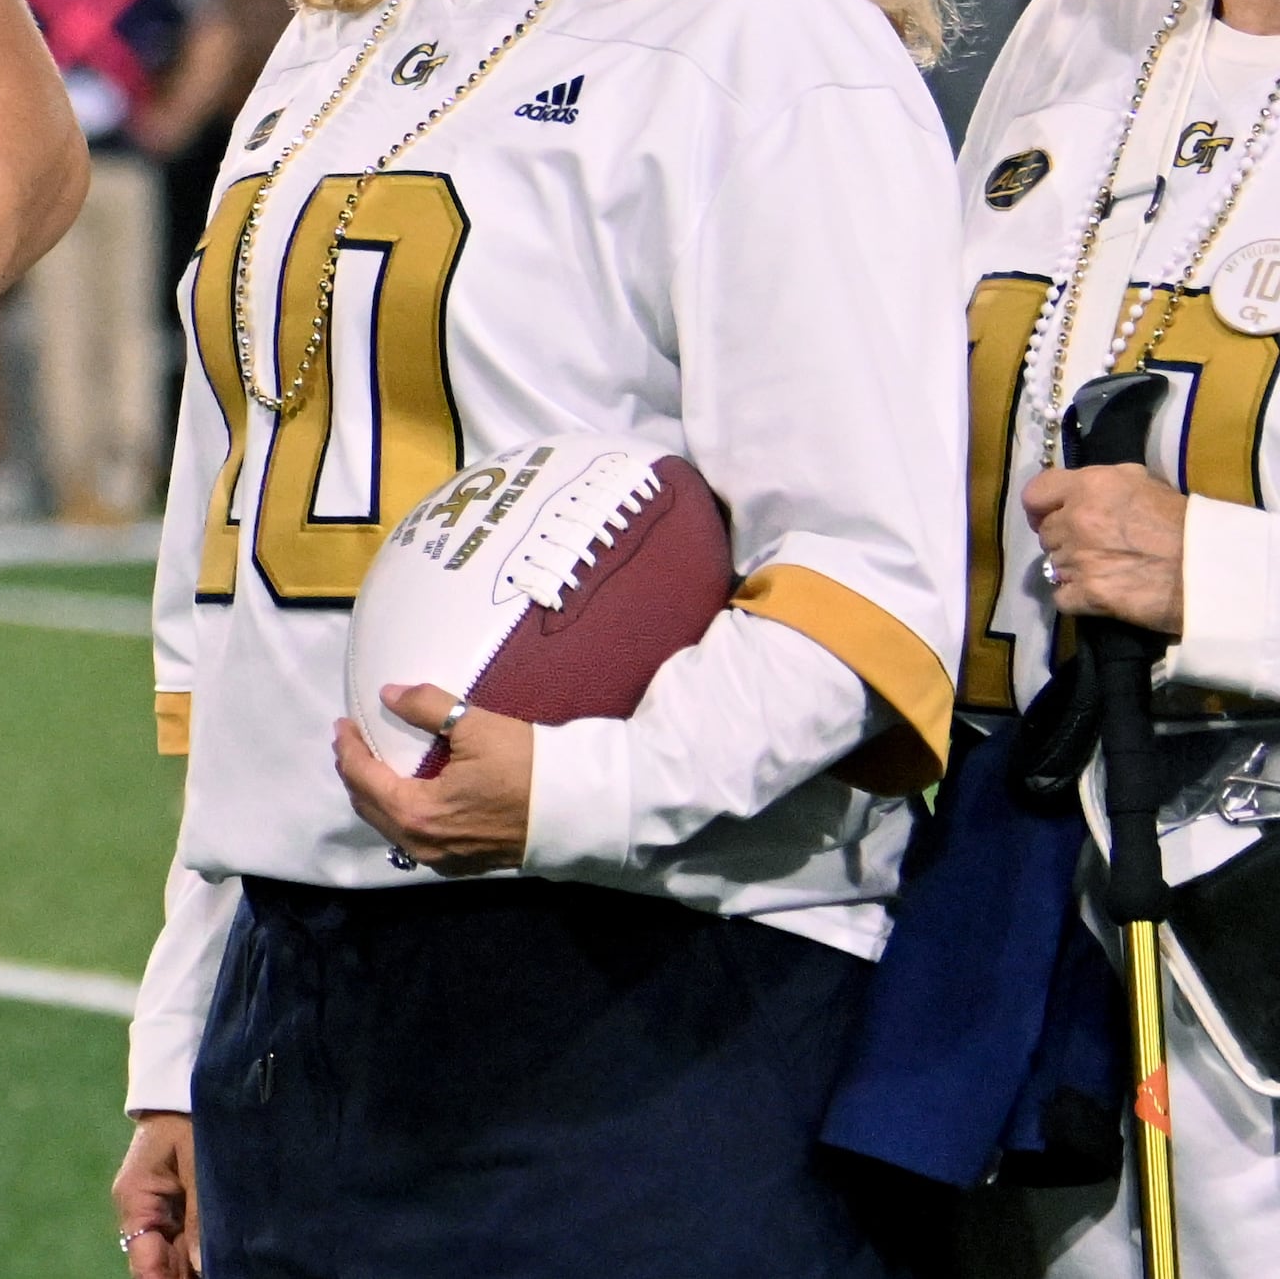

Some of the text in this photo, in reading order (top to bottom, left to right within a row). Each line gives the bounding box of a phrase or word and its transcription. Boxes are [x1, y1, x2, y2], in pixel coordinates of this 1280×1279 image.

[391, 40, 450, 90] GT
[514, 103, 579, 125] adidas
[1173, 120, 1234, 174] GT
[992, 162, 1042, 190] ACC
[1243, 258, 1280, 302] 10
[1239, 305, 1268, 324] GT
[191, 170, 471, 609] 10
[426, 467, 506, 528] GT
